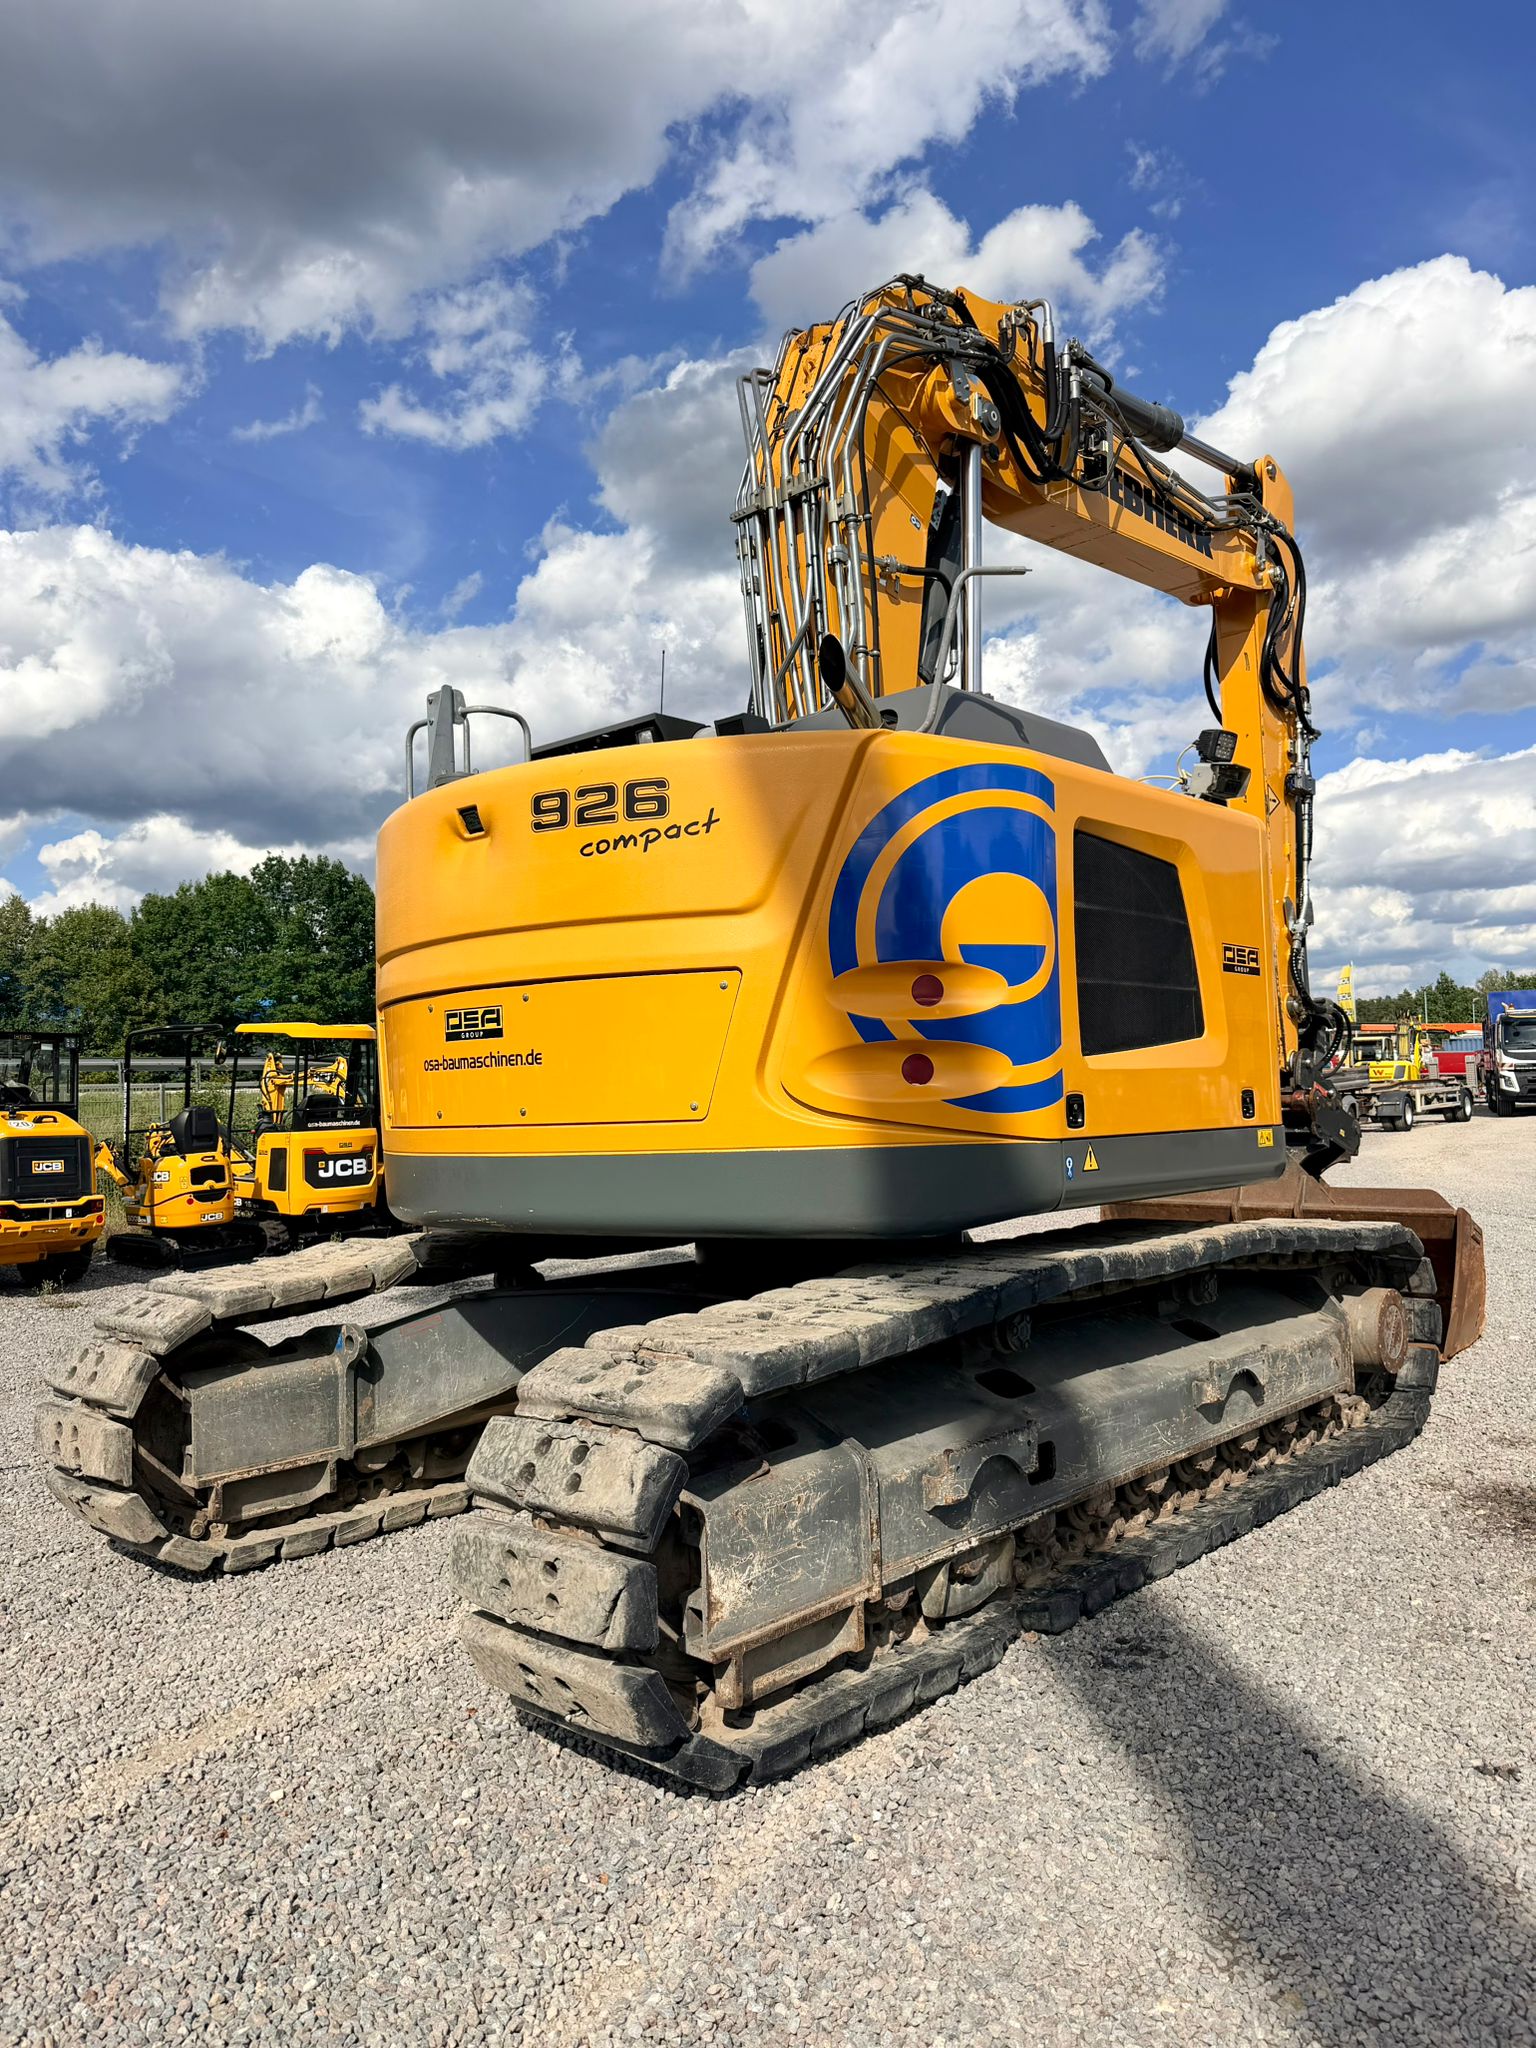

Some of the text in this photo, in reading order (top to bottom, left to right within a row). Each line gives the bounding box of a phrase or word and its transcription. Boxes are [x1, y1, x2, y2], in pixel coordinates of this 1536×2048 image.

[531, 777, 670, 833] 926
[579, 807, 721, 858] compact
[1234, 965, 1250, 973] GROUP
[460, 1031, 485, 1039] GROUP
[423, 1048, 543, 1072] osa-baumaschinen.de
[34, 1162, 62, 1171] JCB
[318, 1158, 367, 1178] JCB
[200, 1212, 224, 1222] JCB
